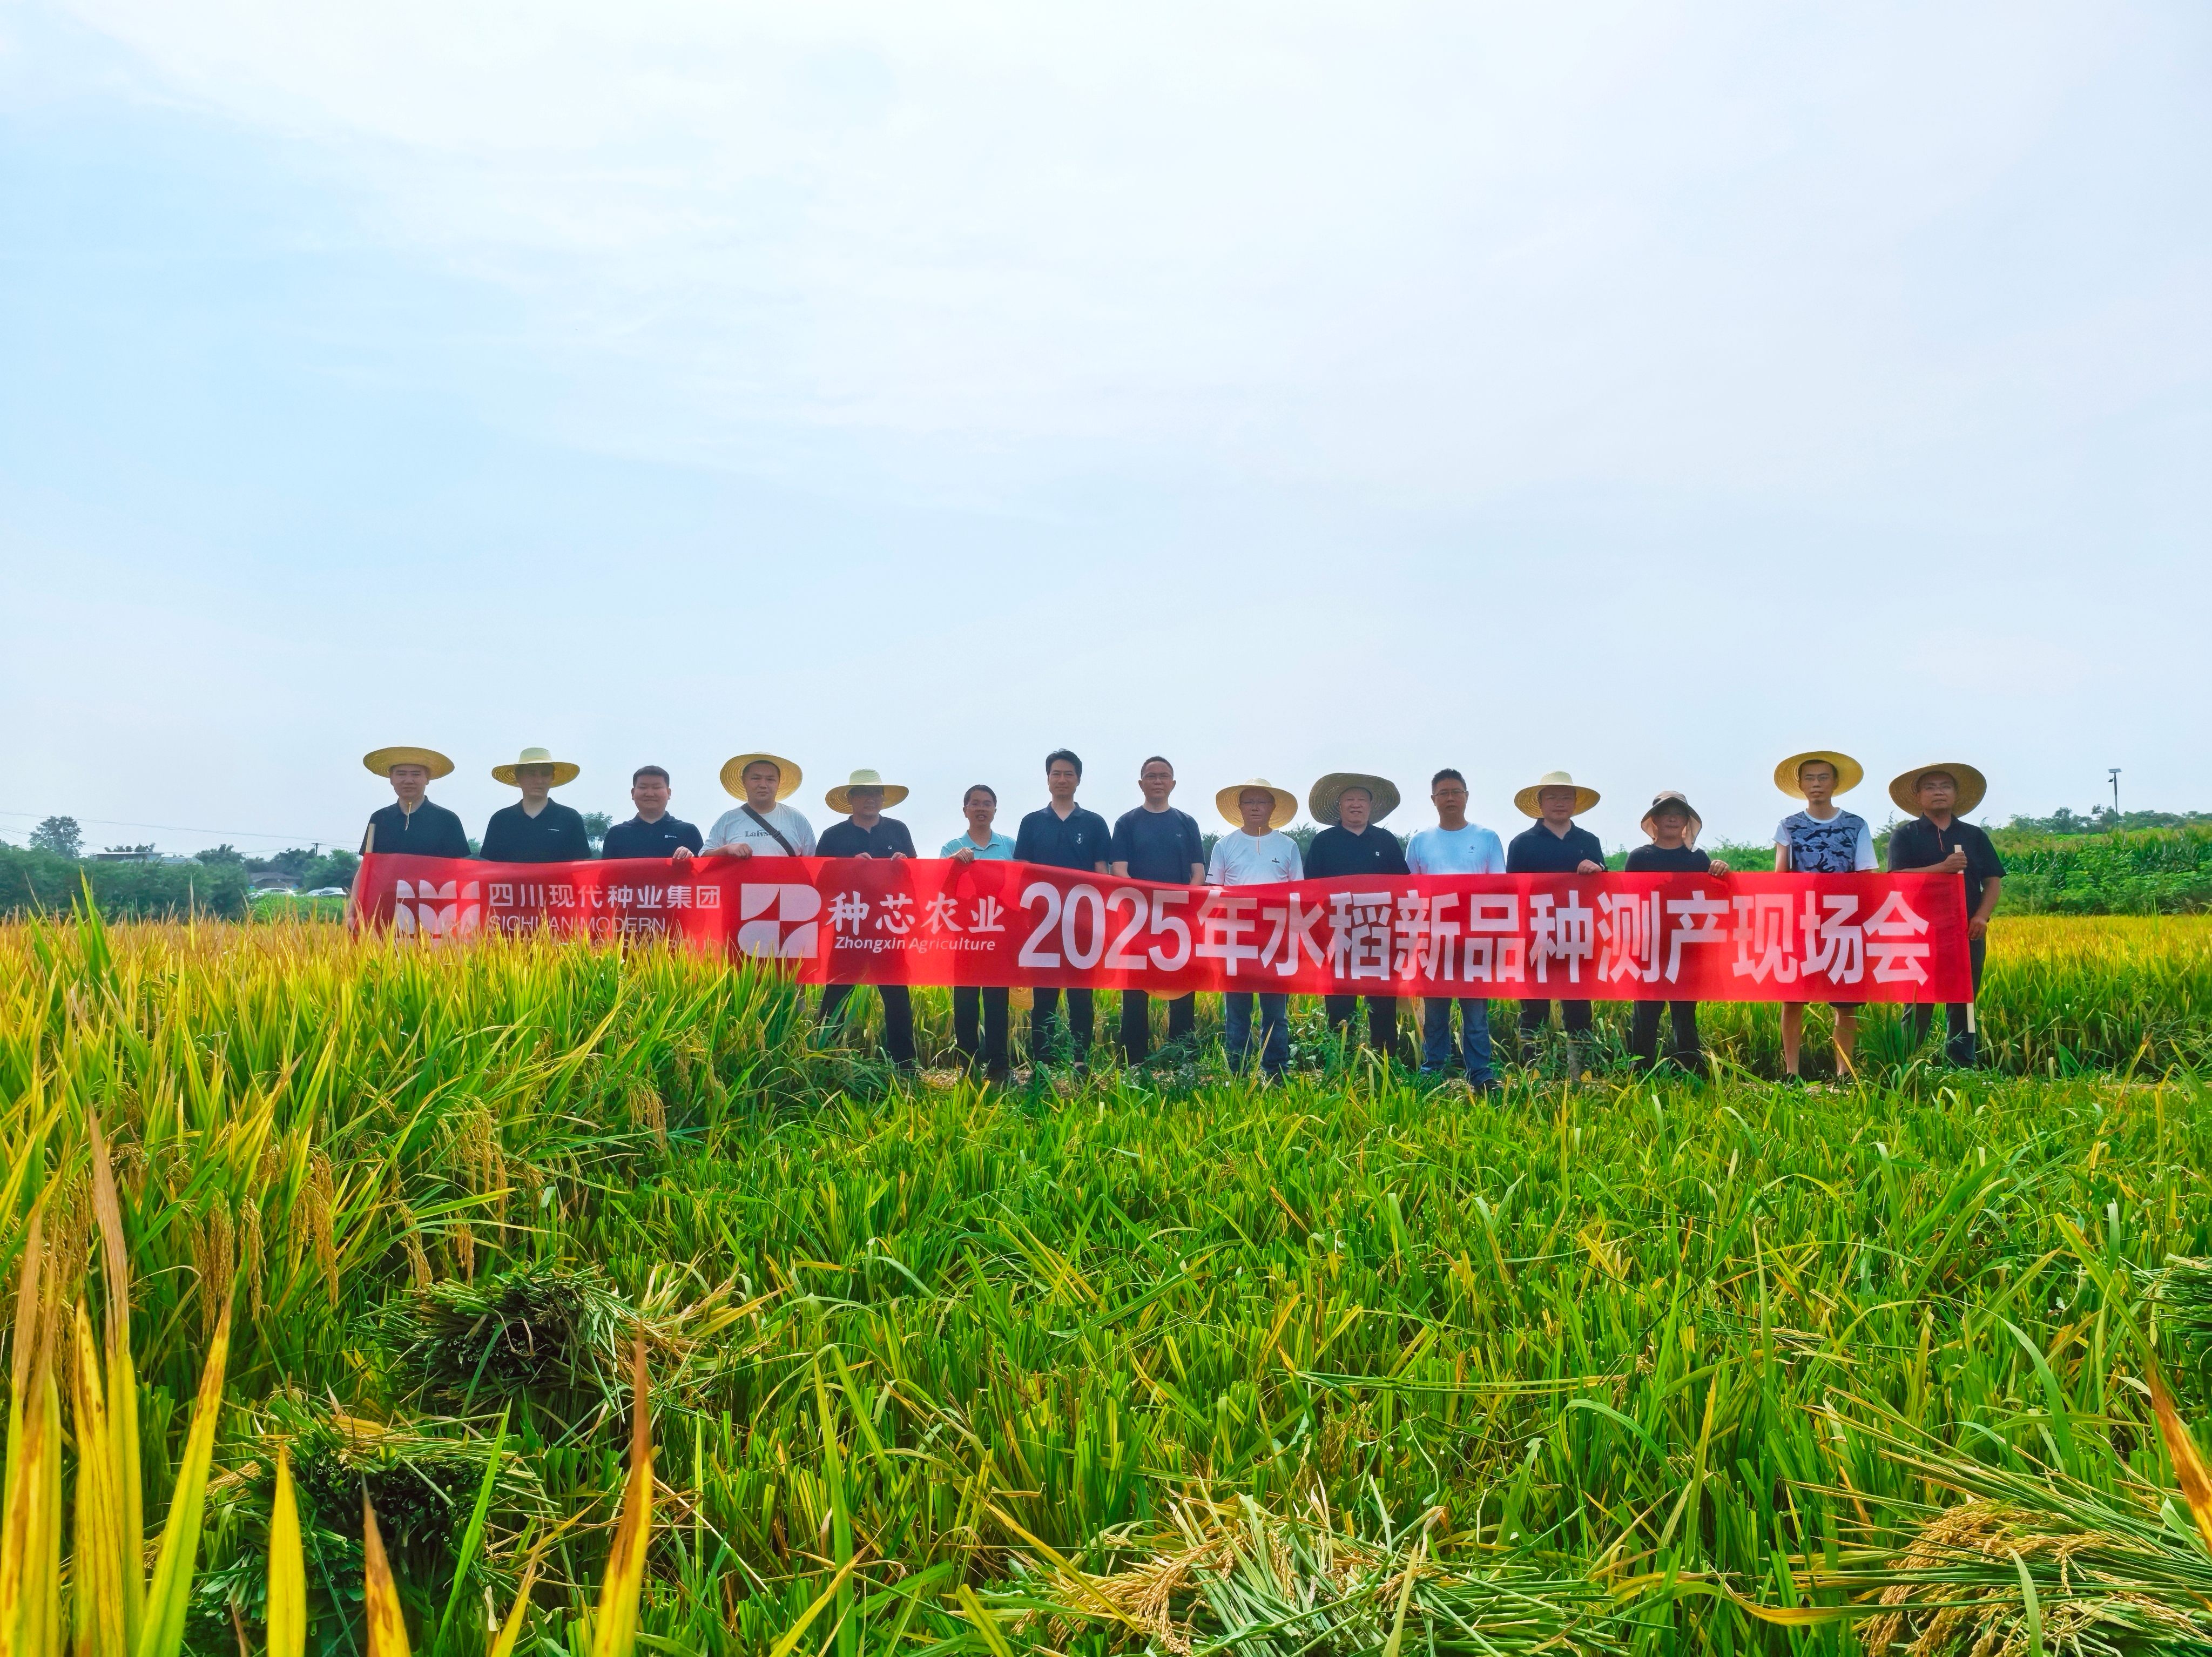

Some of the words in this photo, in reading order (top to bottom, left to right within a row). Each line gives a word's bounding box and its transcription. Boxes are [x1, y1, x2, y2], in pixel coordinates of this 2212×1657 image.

[488, 883, 720, 910] 四川现代种业集团
[579, 916, 666, 933] MODERN
[825, 890, 1006, 935] 种芯农业
[834, 936, 906, 953] Zhongxin
[908, 937, 995, 954] Agriculture
[1018, 881, 1930, 986] 2025年水稻新品种测产现场会
